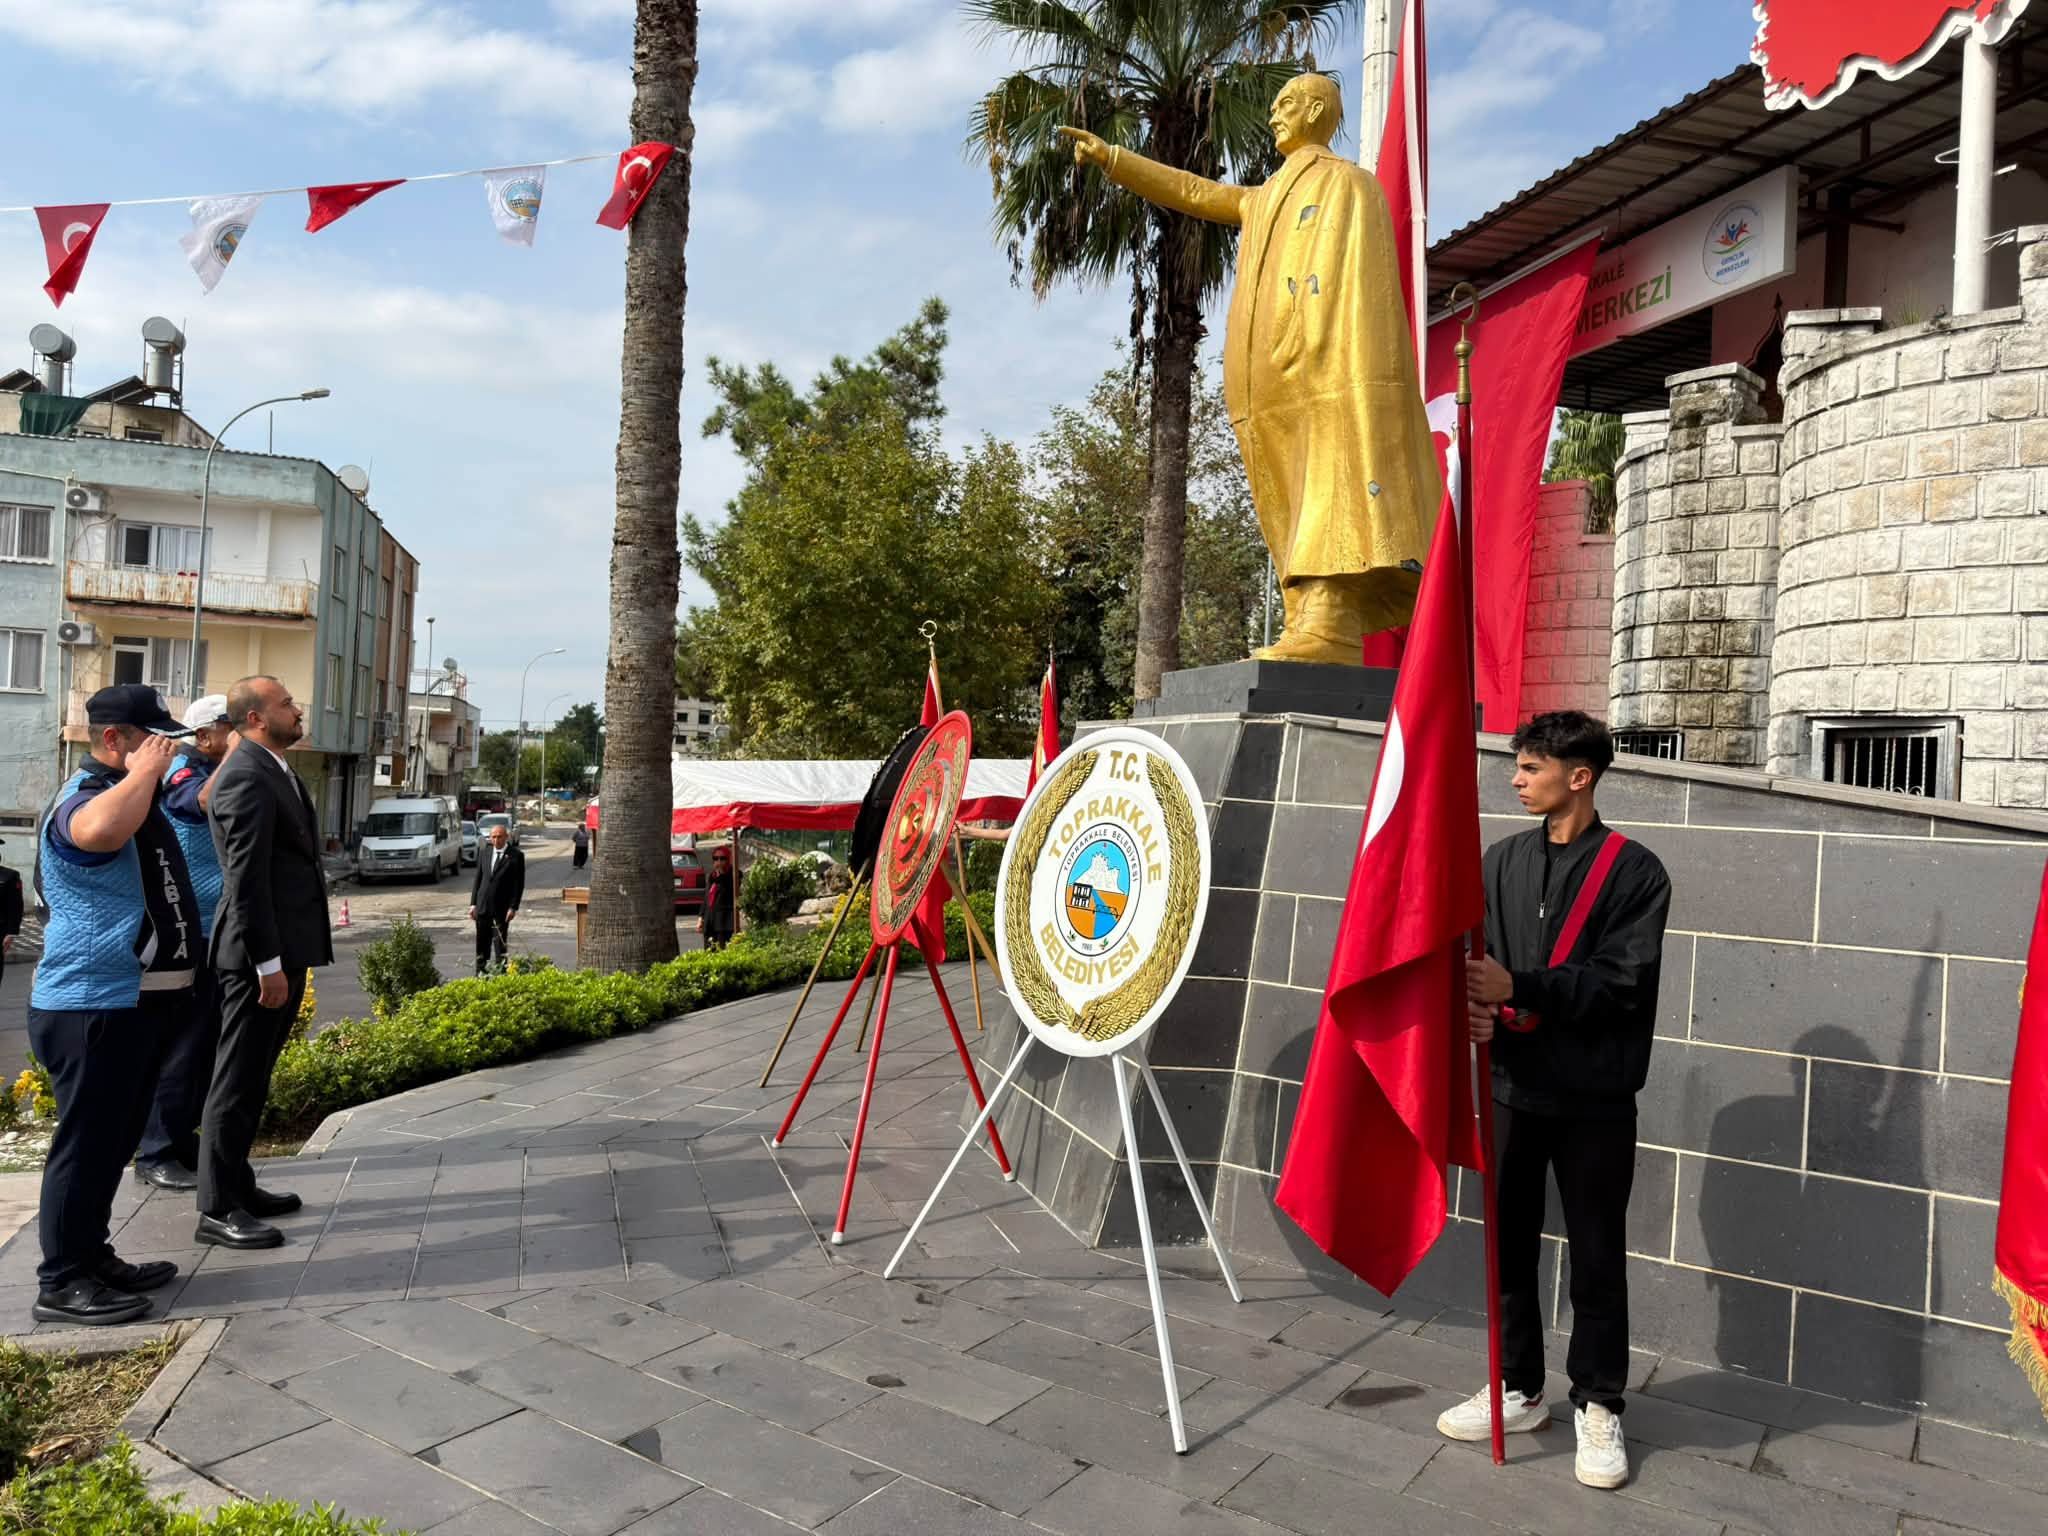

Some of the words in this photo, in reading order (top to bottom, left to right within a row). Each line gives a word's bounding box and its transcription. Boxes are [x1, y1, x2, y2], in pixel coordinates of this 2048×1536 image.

[1110, 750, 1140, 783] T.C.
[1049, 795, 1162, 884] TOPRAKKALE
[1063, 828, 1108, 872] TOPRAKKALE
[1112, 830, 1139, 882] BELEDİYESİ
[155, 848, 188, 960] ZABITA
[1039, 920, 1140, 986] BELEDİYESİ
